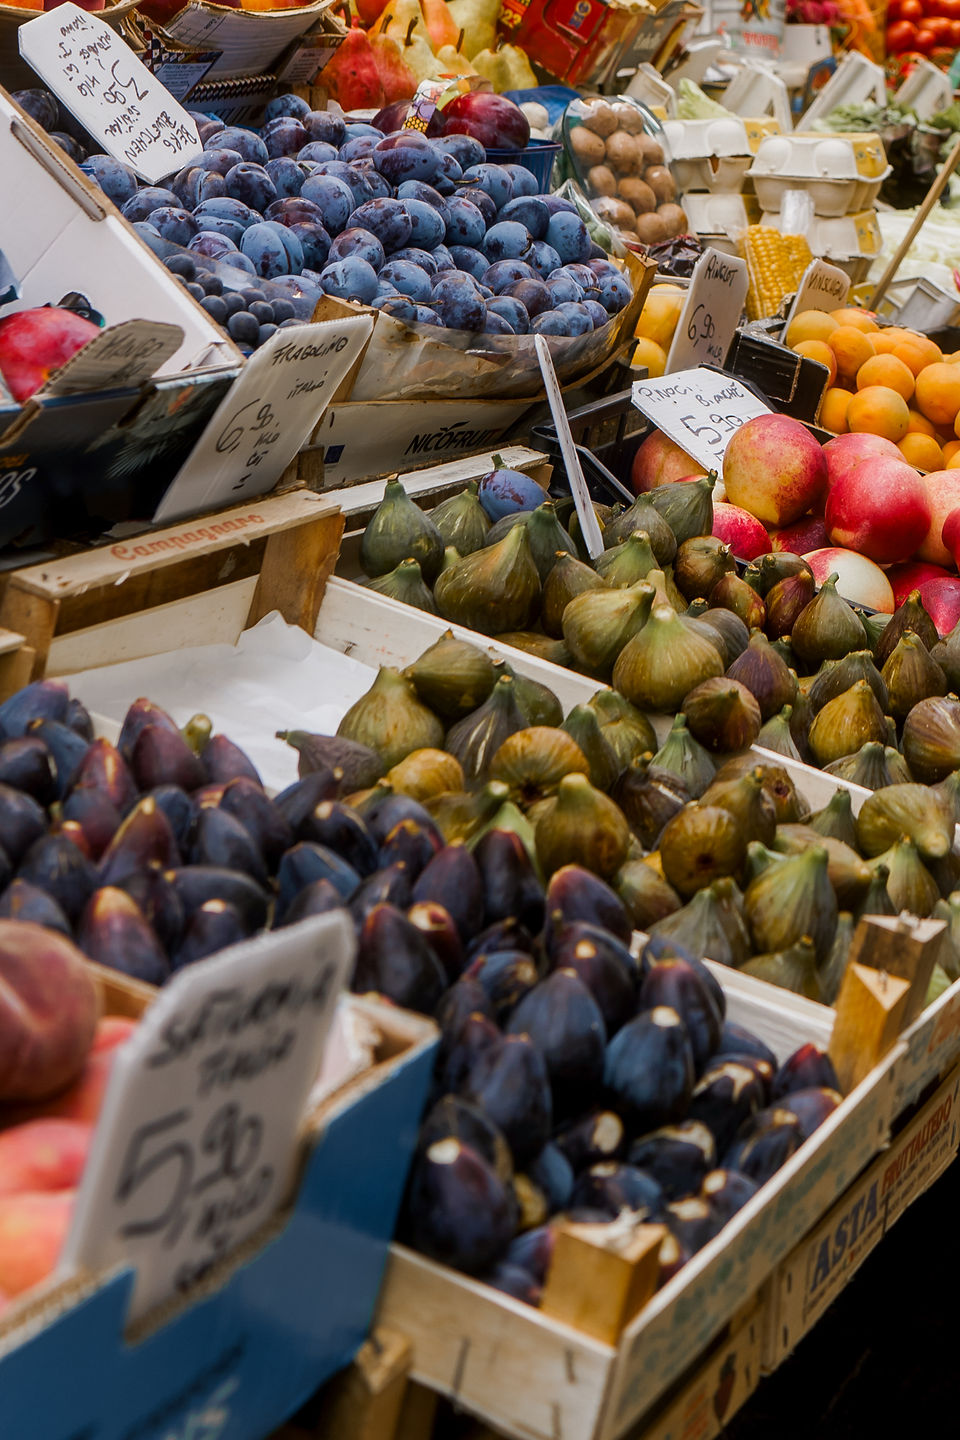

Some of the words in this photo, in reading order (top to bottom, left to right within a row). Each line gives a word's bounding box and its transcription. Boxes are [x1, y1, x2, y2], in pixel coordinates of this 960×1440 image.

[163, 124, 197, 153] BERG
[110, 514, 265, 561] Campagnaro
[810, 1179, 879, 1294] ASTA
